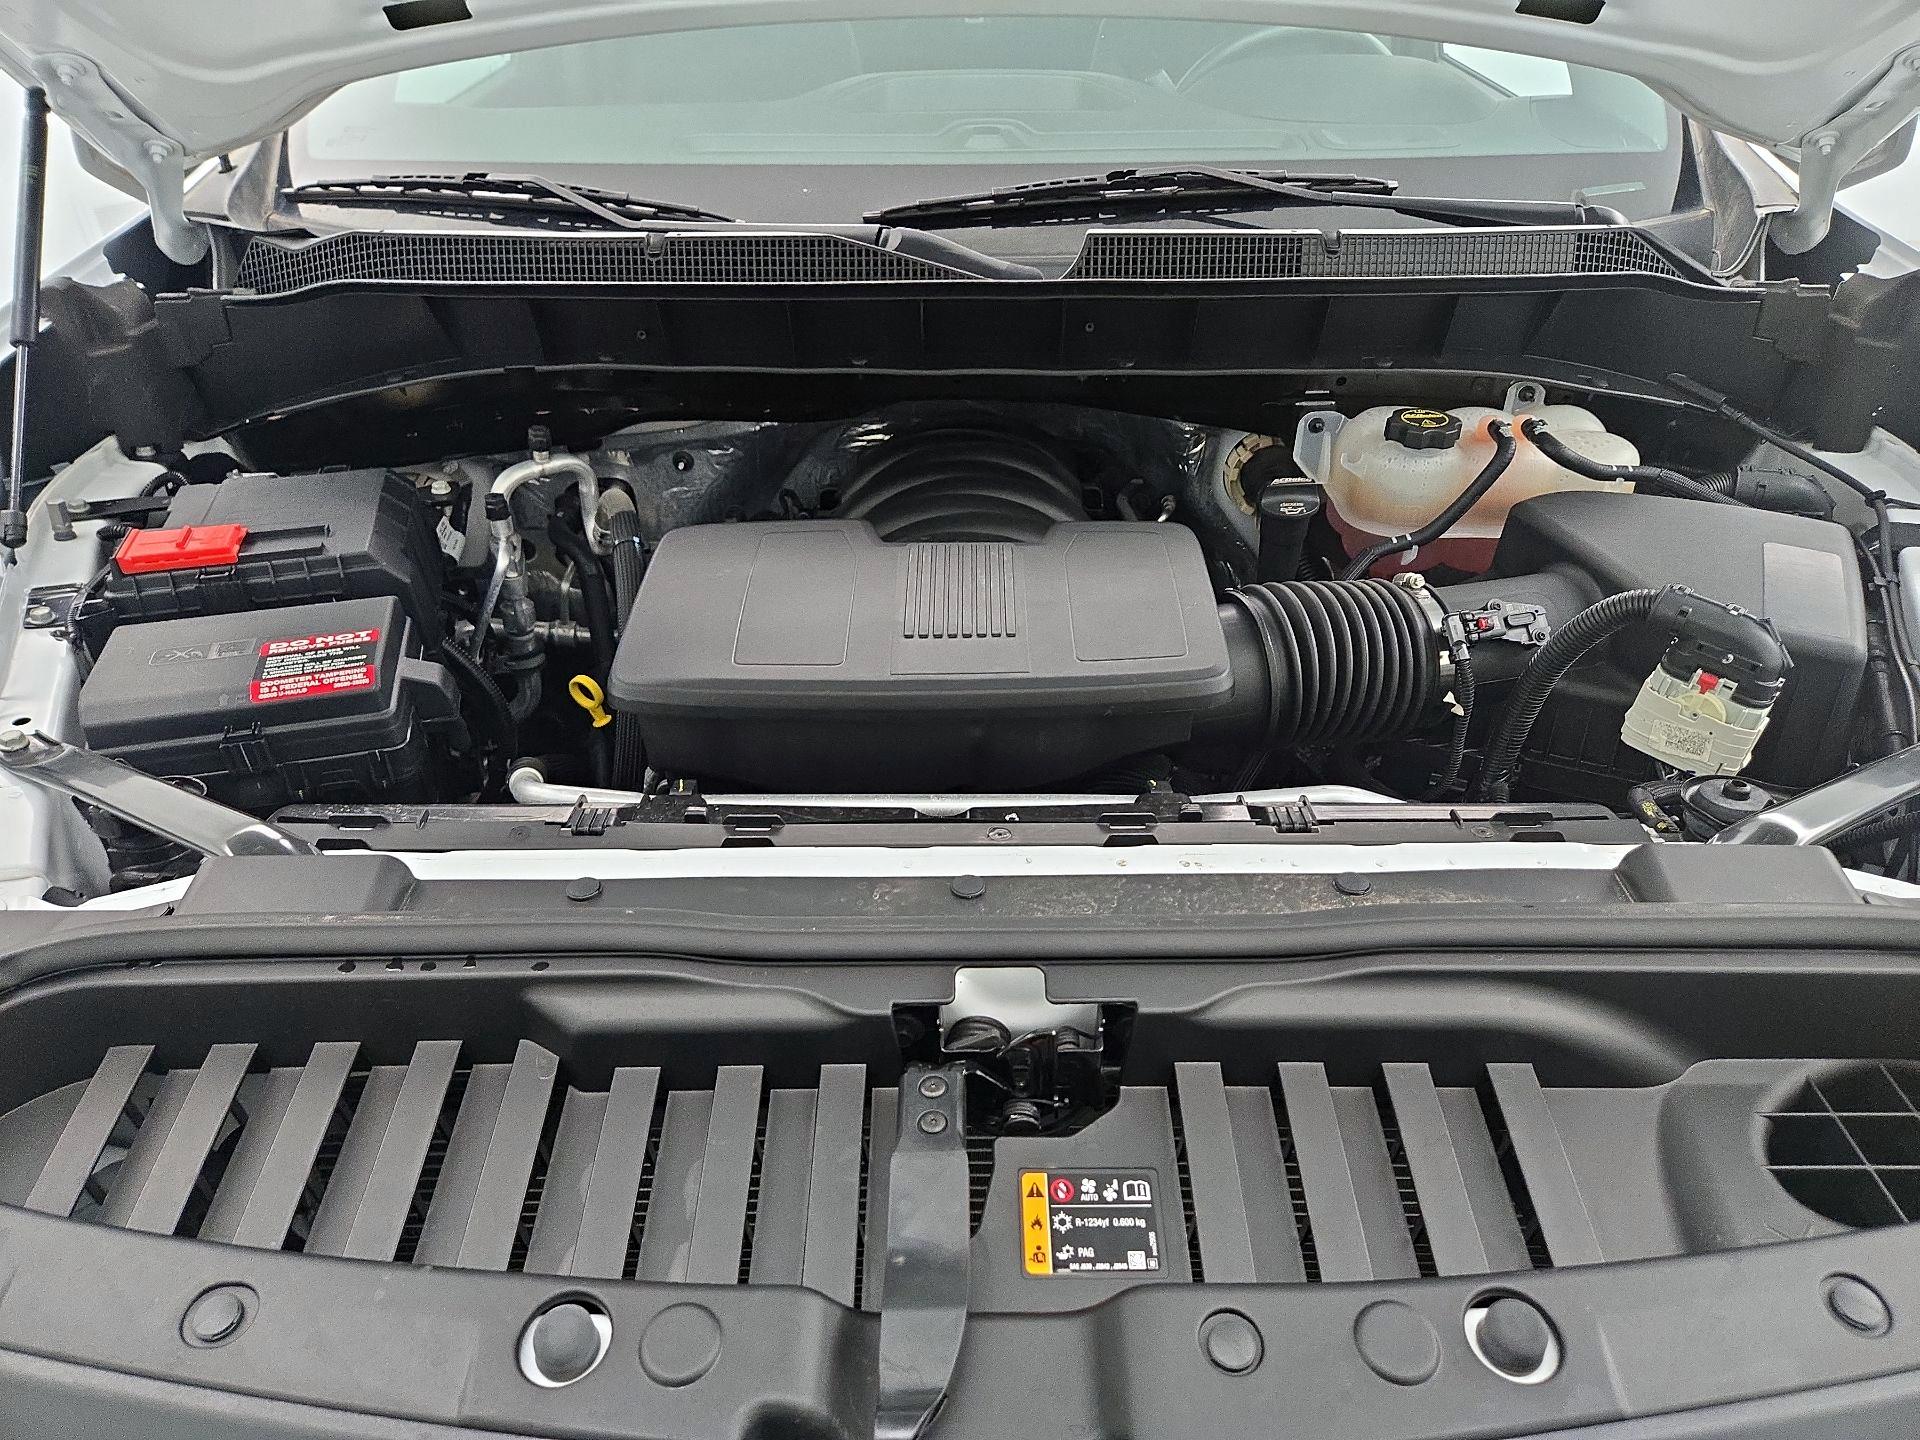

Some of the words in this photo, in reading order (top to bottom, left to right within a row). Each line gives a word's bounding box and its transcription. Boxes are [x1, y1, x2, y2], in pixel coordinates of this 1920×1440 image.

[268, 642, 325, 655] REMOVE
[328, 636, 371, 646] FUSES
[269, 639, 310, 650] DO
[315, 630, 372, 644] NOT
[260, 675, 312, 687] ODOMETER
[314, 667, 367, 679] TAMPERING
[279, 680, 320, 691] FEDERAL
[322, 672, 366, 684] OFFENSE.
[1075, 1217, 1110, 1228] R-1234yf
[1113, 1218, 1135, 1227] 0.600
[1135, 1218, 1146, 1228] kg
[1078, 1247, 1095, 1258] PAG
